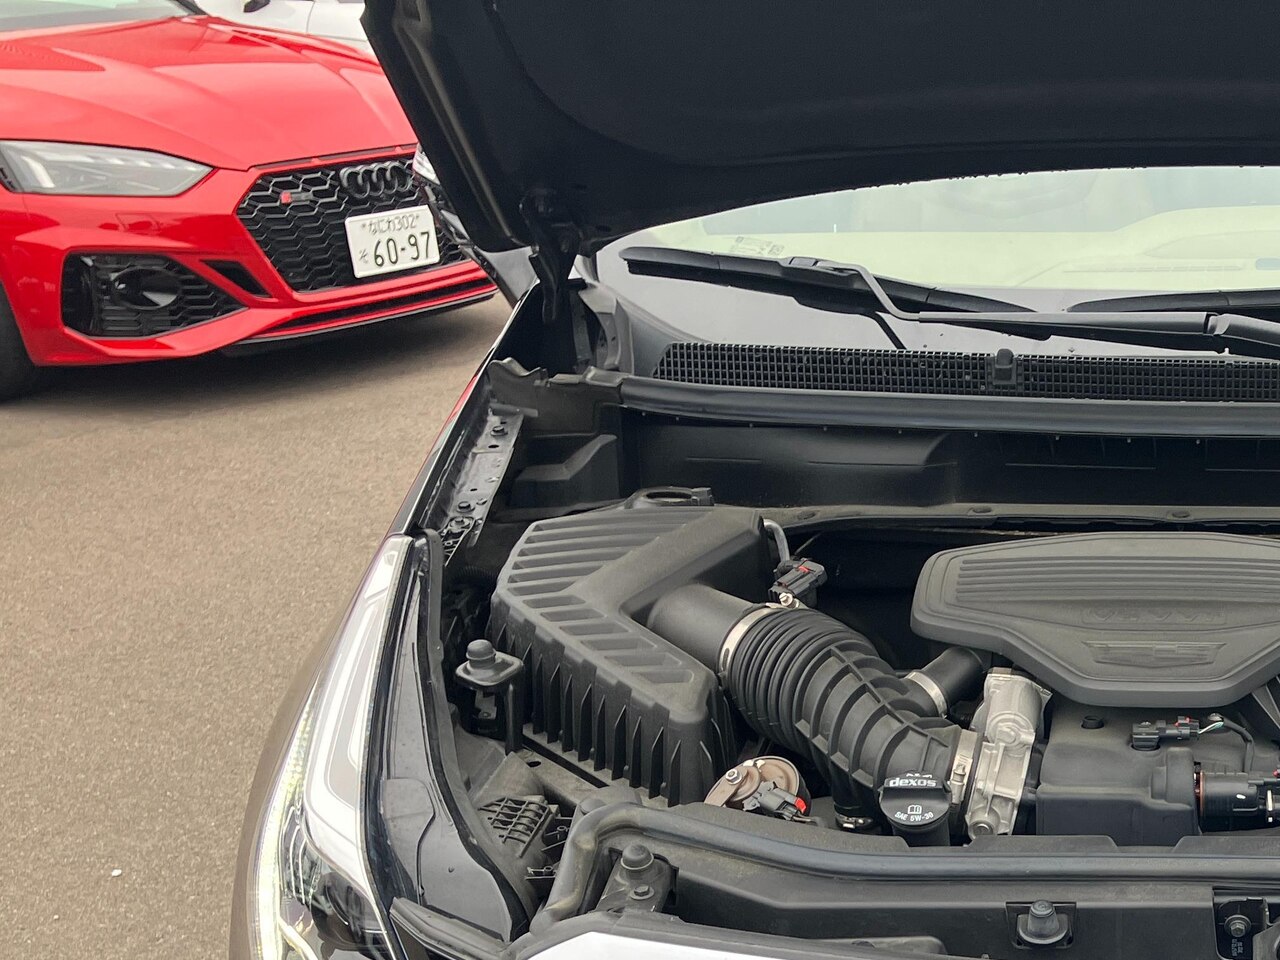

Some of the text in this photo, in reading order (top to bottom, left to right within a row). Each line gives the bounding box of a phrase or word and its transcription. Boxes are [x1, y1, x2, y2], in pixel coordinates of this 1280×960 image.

[374, 231, 430, 267] 60-97
[889, 777, 937, 787] dexos
[894, 811, 909, 821] SAE
